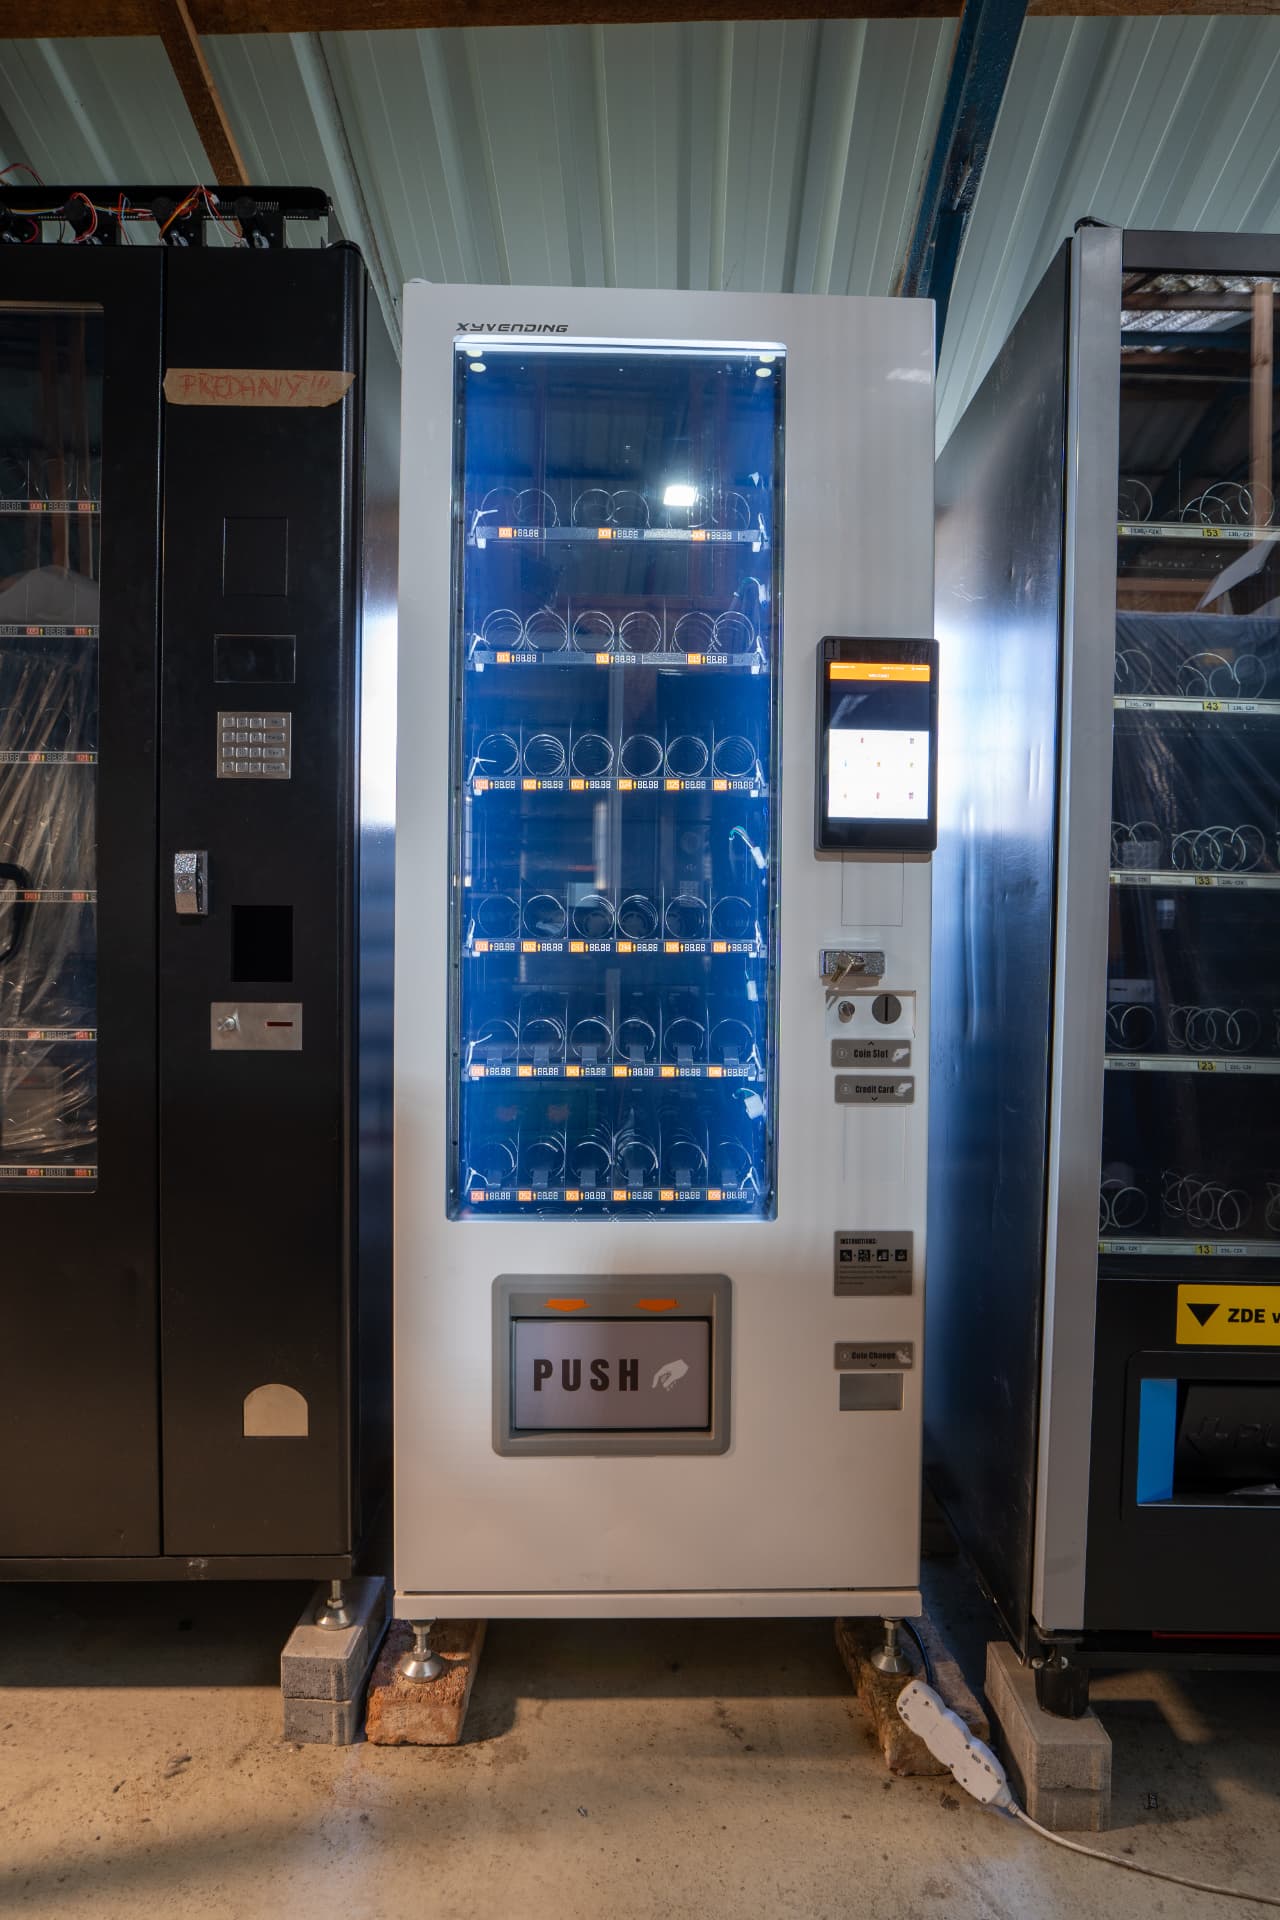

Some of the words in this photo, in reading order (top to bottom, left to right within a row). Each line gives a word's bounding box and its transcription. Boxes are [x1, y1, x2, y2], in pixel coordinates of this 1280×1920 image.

[456, 322, 569, 333] XYVENDING
[1207, 529, 1218, 537] 53
[1206, 702, 1219, 711] 43
[1201, 1062, 1214, 1071] 23
[856, 1085, 877, 1094] Credit
[878, 1085, 895, 1094] Card
[1199, 1245, 1210, 1254] 13
[1228, 1308, 1266, 1324] ZDE
[533, 1358, 639, 1392] PUSH
